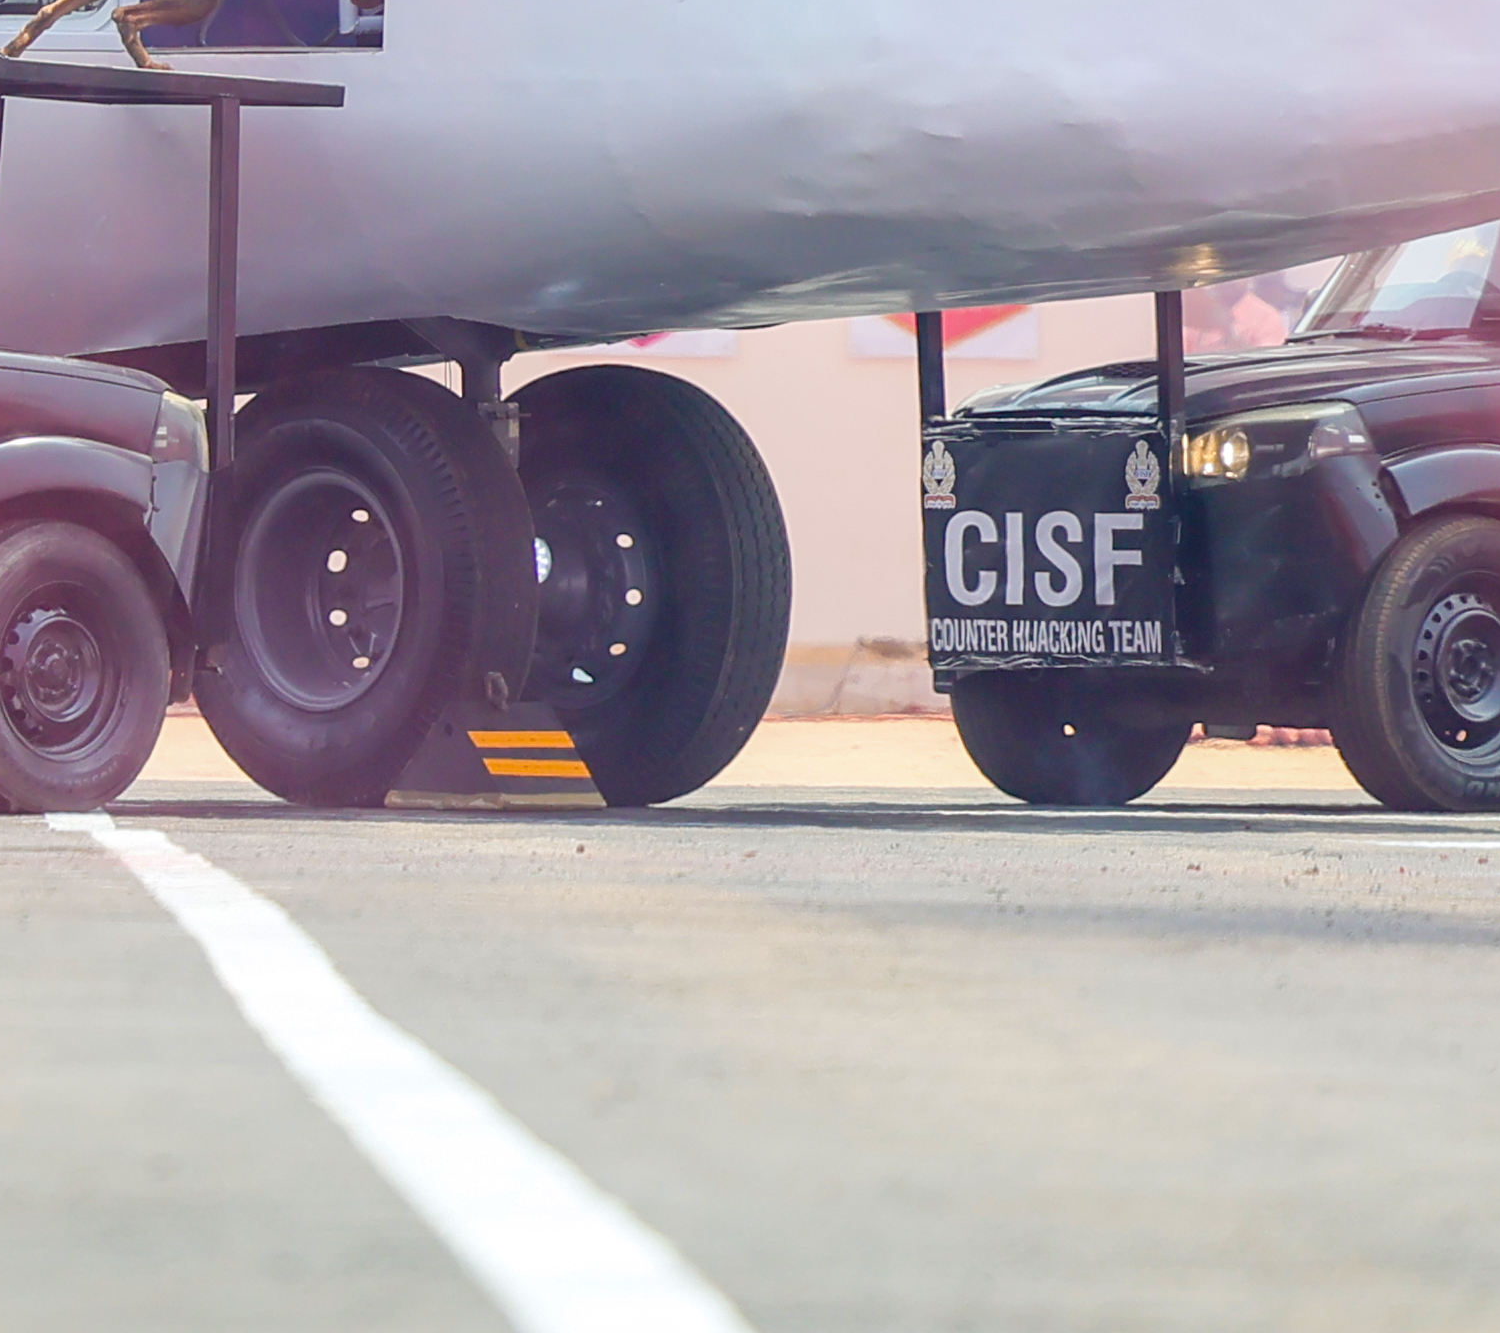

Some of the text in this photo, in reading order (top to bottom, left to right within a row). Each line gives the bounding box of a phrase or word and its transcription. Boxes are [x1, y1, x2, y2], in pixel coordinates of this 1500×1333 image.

[944, 510, 1145, 607] CISF
[931, 617, 1162, 654] COUNTER HIJACKING TEAM
